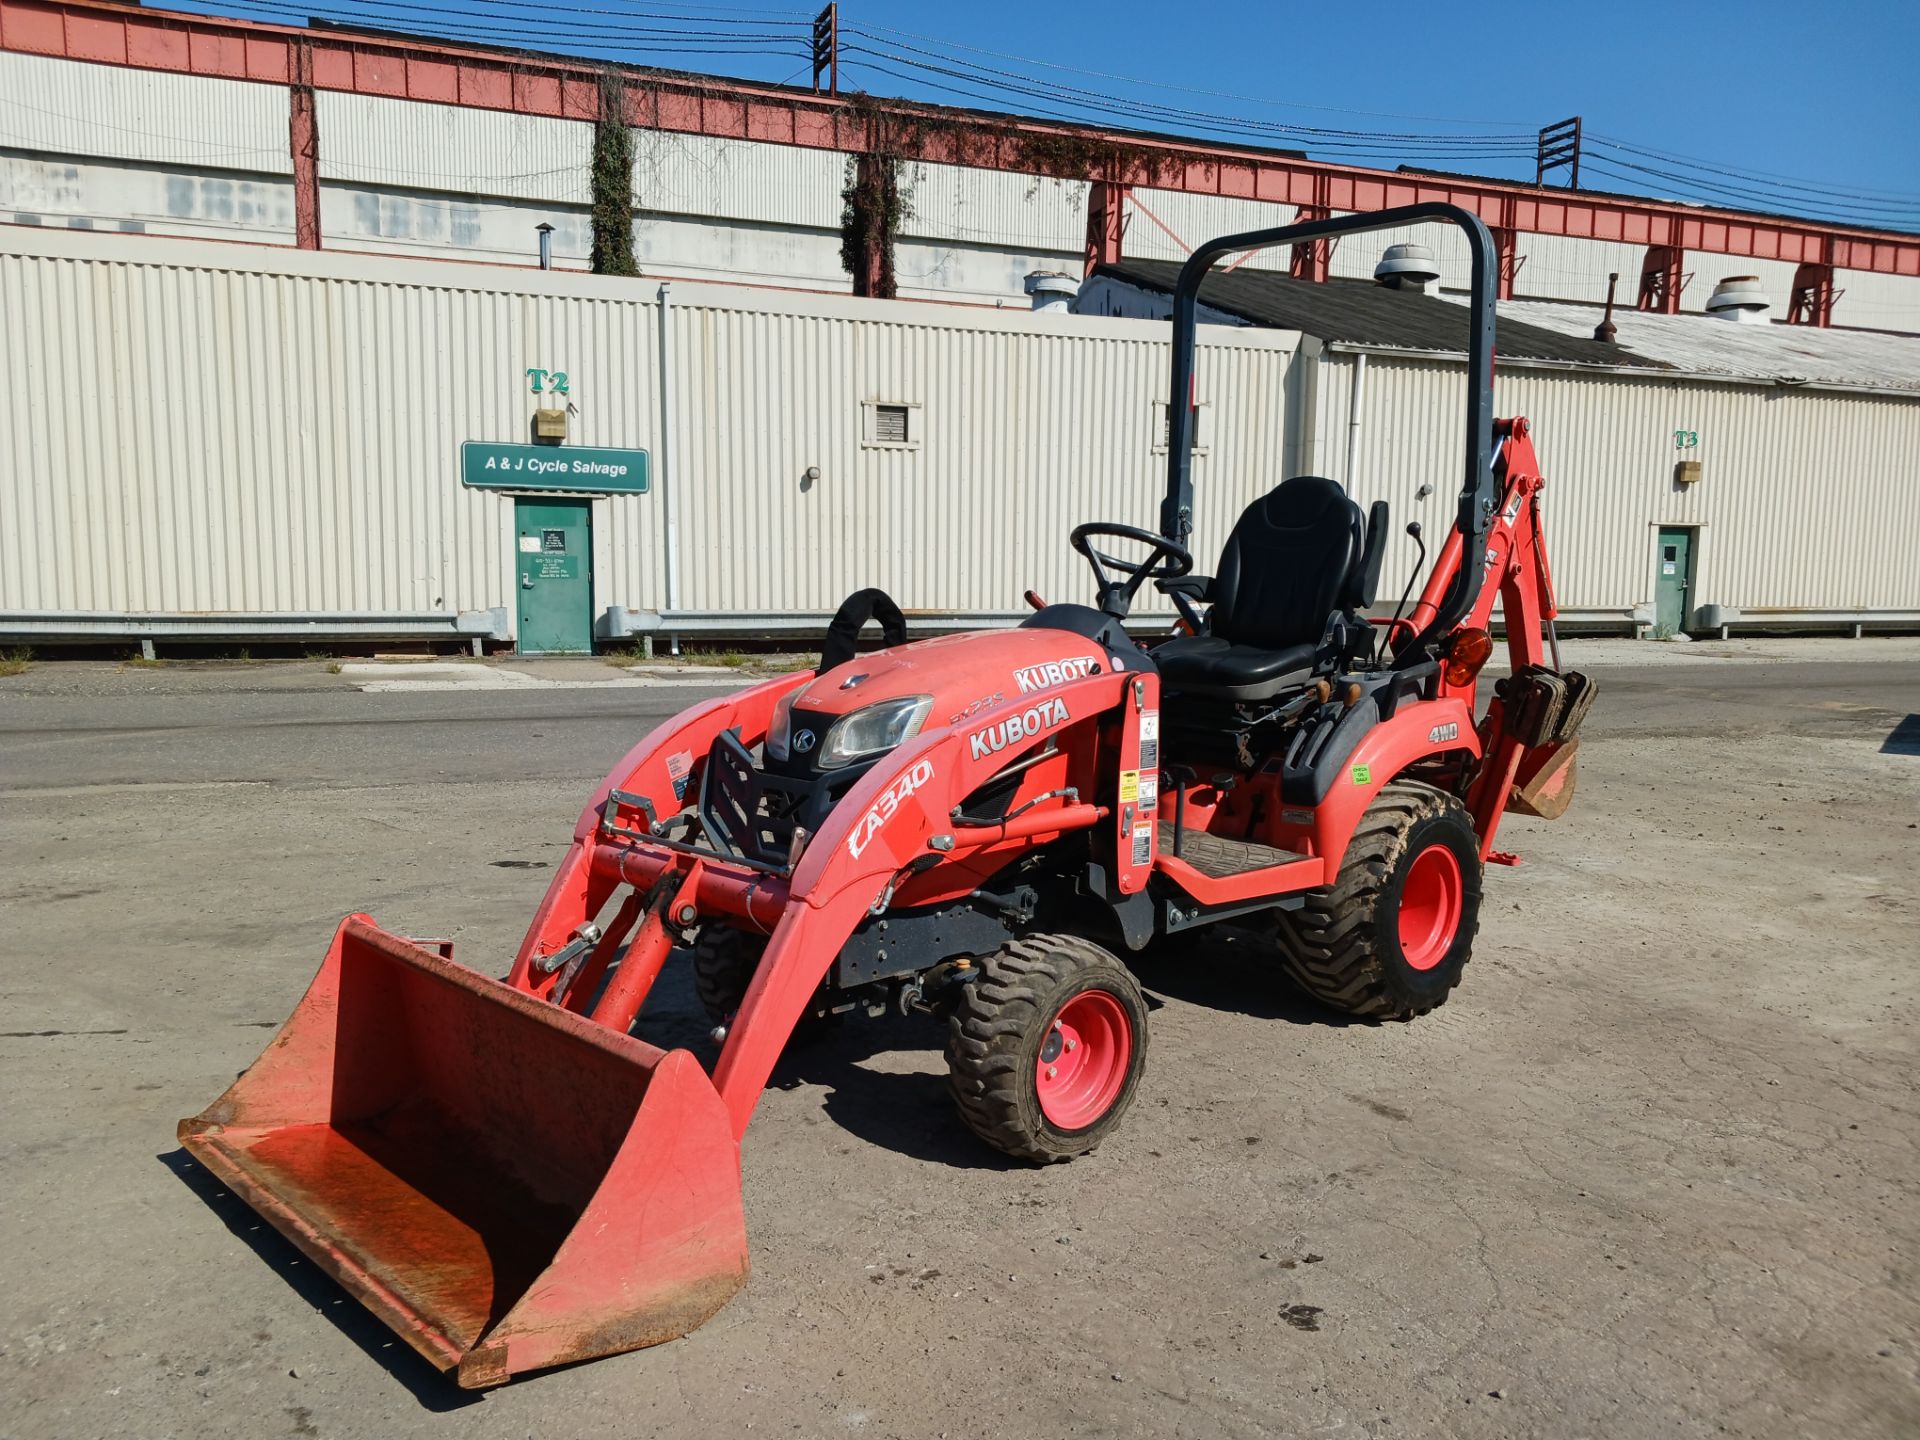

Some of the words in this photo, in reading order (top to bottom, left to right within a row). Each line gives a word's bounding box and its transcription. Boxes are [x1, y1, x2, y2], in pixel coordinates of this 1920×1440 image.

[1675, 430, 1698, 447] T3
[484, 456, 497, 470] A
[500, 458, 511, 470] &
[514, 458, 524, 471] J
[527, 458, 569, 475] Cycle
[572, 460, 628, 478] Salvage
[969, 697, 1071, 762] KUBOTA
[1428, 721, 1459, 745] 4WD
[848, 757, 935, 860] CA340
